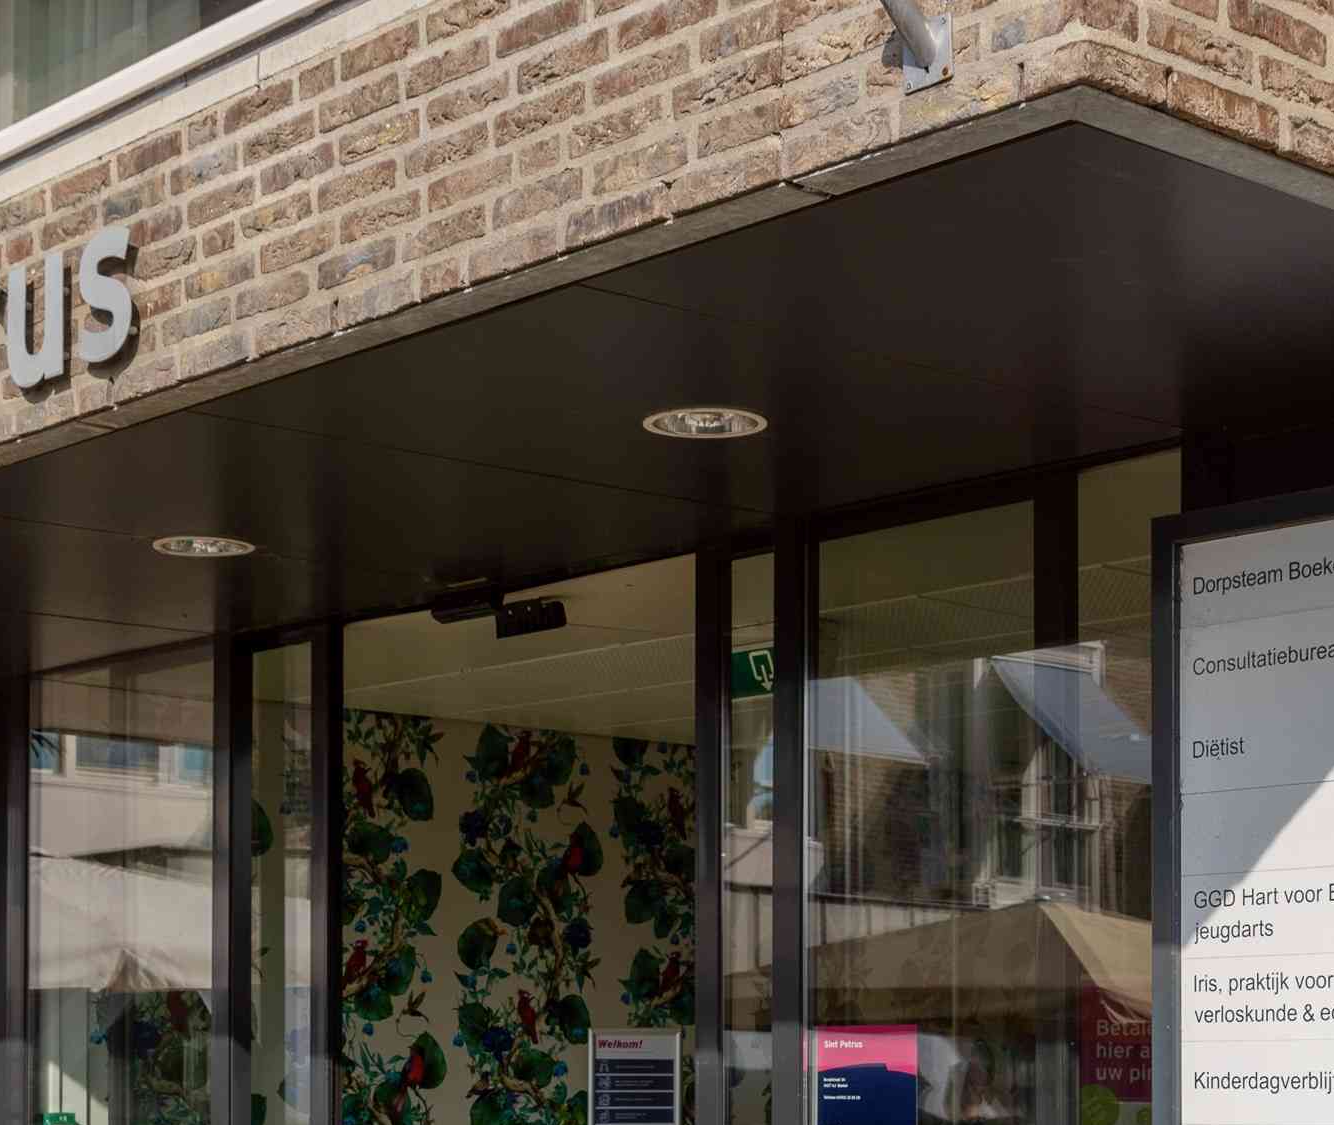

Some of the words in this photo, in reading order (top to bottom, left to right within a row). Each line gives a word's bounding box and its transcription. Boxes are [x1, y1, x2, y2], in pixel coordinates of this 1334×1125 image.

[1192, 567, 1284, 596] Dorpsteam
[1192, 736, 1244, 760] Diëtist
[1194, 889, 1236, 910] GGD
[1241, 887, 1279, 907] Hart
[1284, 887, 1322, 905] voor
[1193, 918, 1274, 946] jeugdarts
[1193, 973, 1223, 995] Iris,
[1228, 971, 1290, 996] praktijk
[1294, 972, 1334, 991] voor
[1194, 1002, 1298, 1025] verloskunde
[1302, 1004, 1316, 1022] &
[597, 1039, 643, 1049] Welkom!
[824, 1039, 839, 1048] Sint
[840, 1040, 863, 1049] Petrus
[1096, 1041, 1134, 1059] hier
[1096, 1067, 1123, 1081] uw
